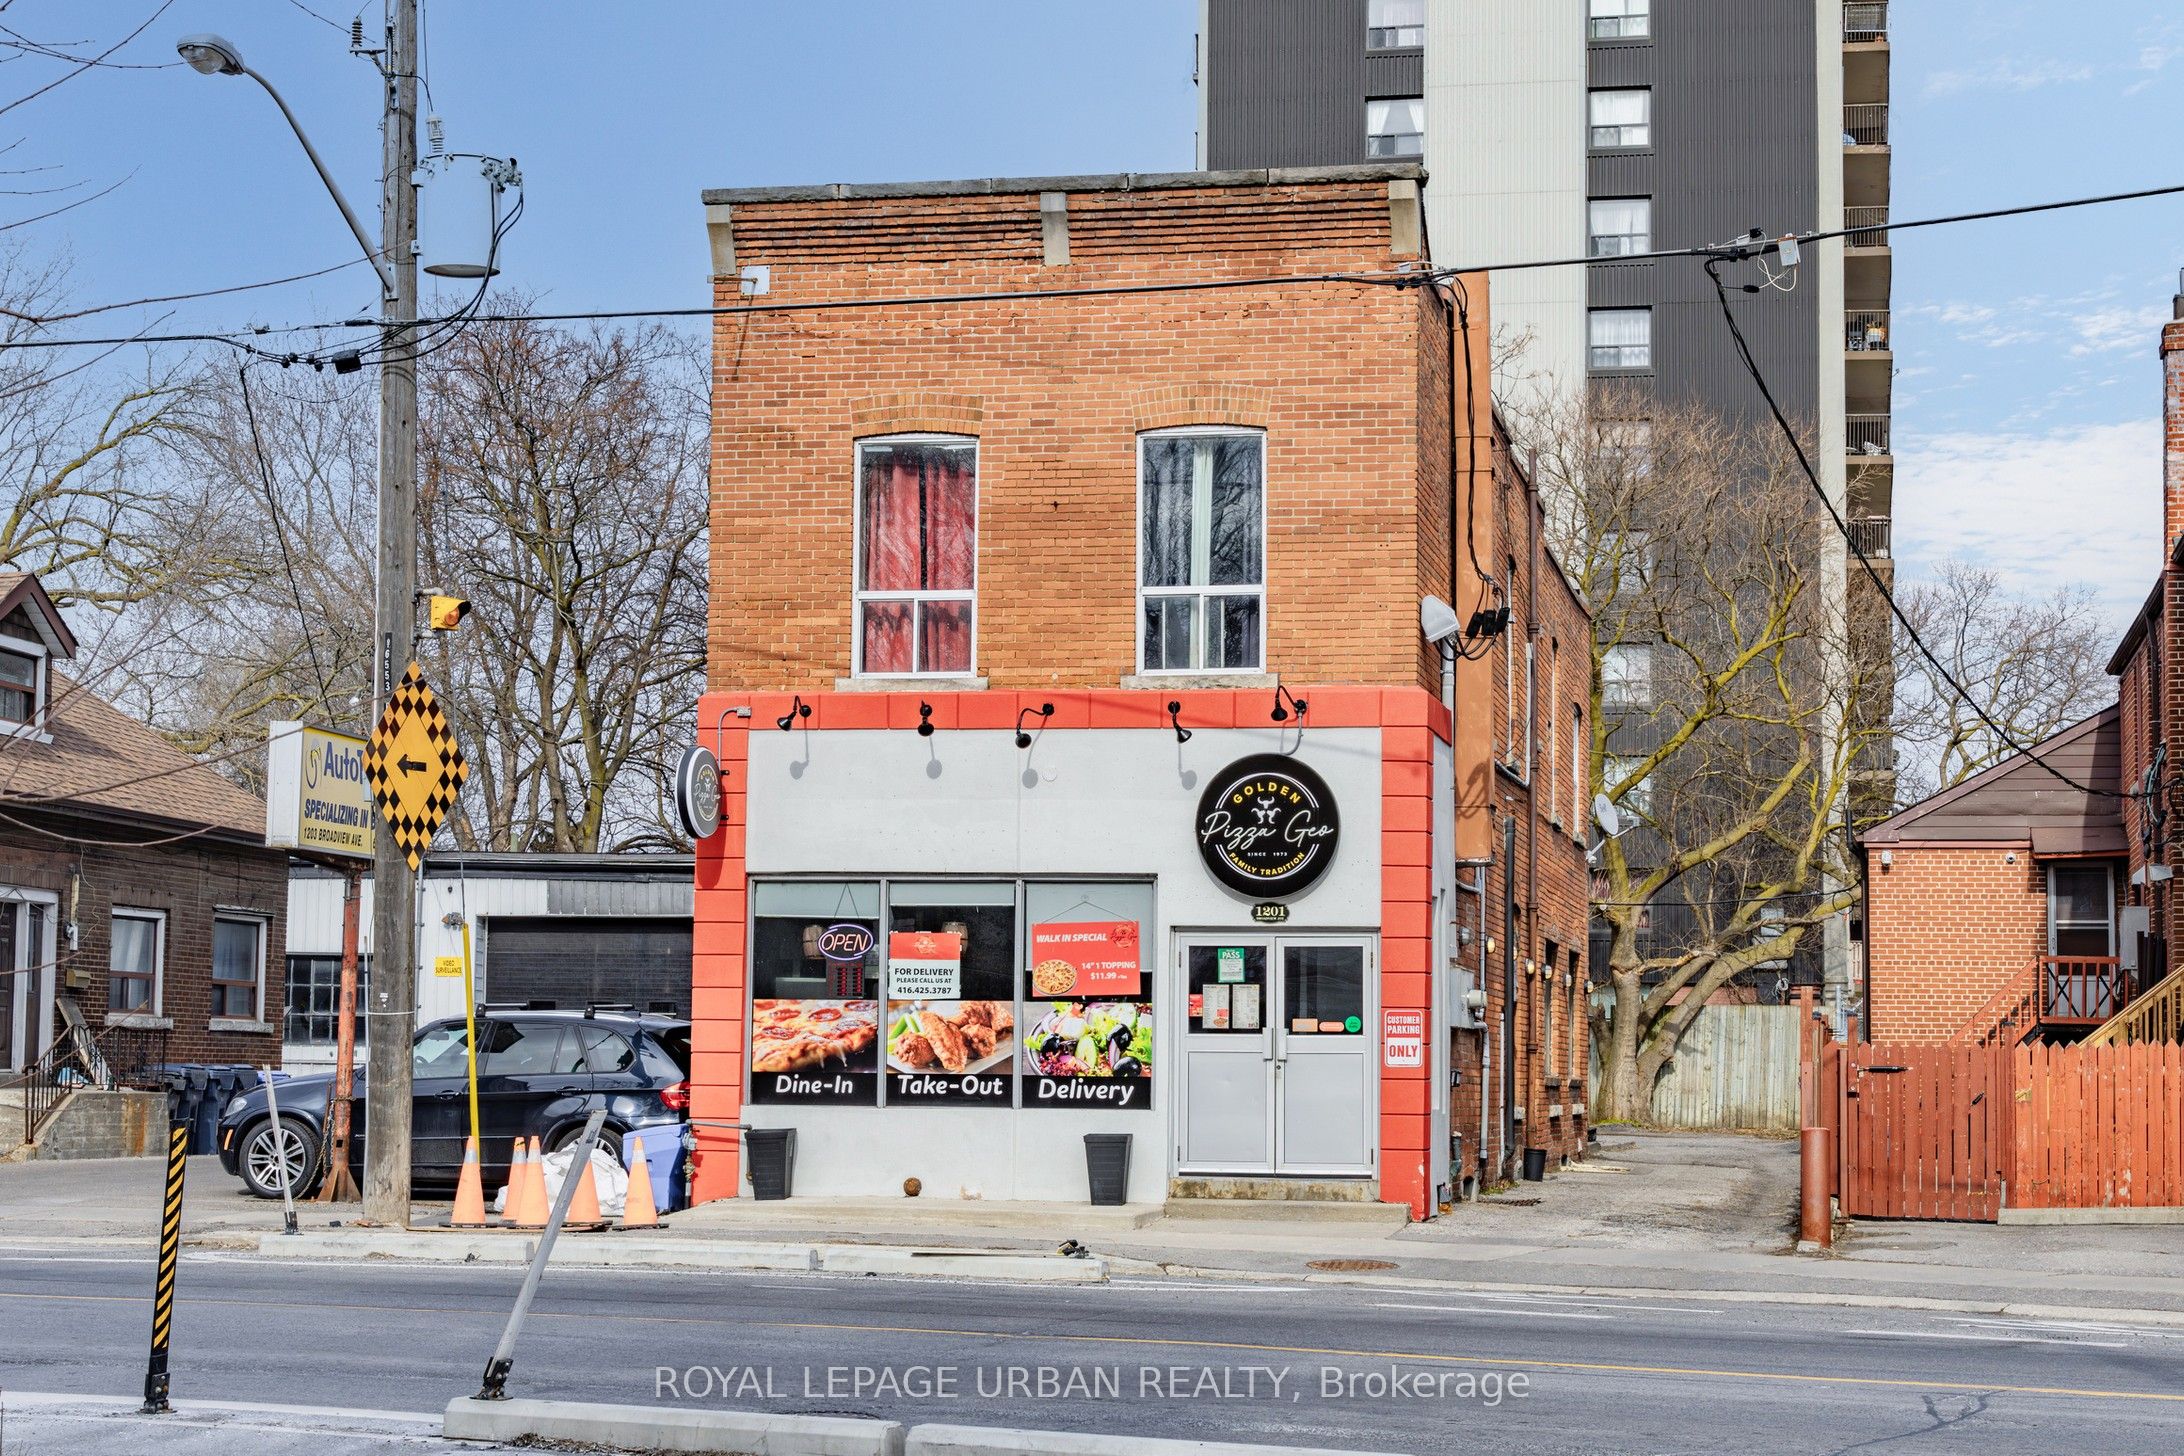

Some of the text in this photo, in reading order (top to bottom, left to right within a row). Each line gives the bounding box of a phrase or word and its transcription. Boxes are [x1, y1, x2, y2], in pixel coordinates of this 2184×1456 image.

[1233, 781, 1302, 804] GOLDEN
[304, 798, 358, 826] SPECIALIZING
[360, 808, 369, 829] IN
[304, 827, 317, 840] 1203
[318, 828, 351, 845] BROADVIEW
[1201, 809, 1334, 851] Pizza Geo
[1228, 852, 1306, 876] FAMILY TRADITION
[1255, 905, 1286, 917] 1201
[821, 933, 868, 951] OPEN
[1036, 933, 1108, 943] WALK IN SPECIAL
[1222, 951, 1240, 959] PASS
[1101, 961, 1136, 970] TOPPING
[894, 968, 954, 976] FOR DELIVERY
[1090, 971, 1117, 980] $11.99
[897, 986, 952, 994] 416.425.3787
[1387, 1015, 1420, 1024] CUSTOMER
[1387, 1025, 1420, 1035] PARKING
[1389, 1045, 1418, 1057] ONLY
[775, 1073, 853, 1094] Dine-In
[897, 1074, 1003, 1095] Take-Out
[1038, 1077, 1135, 1106] Delivery
